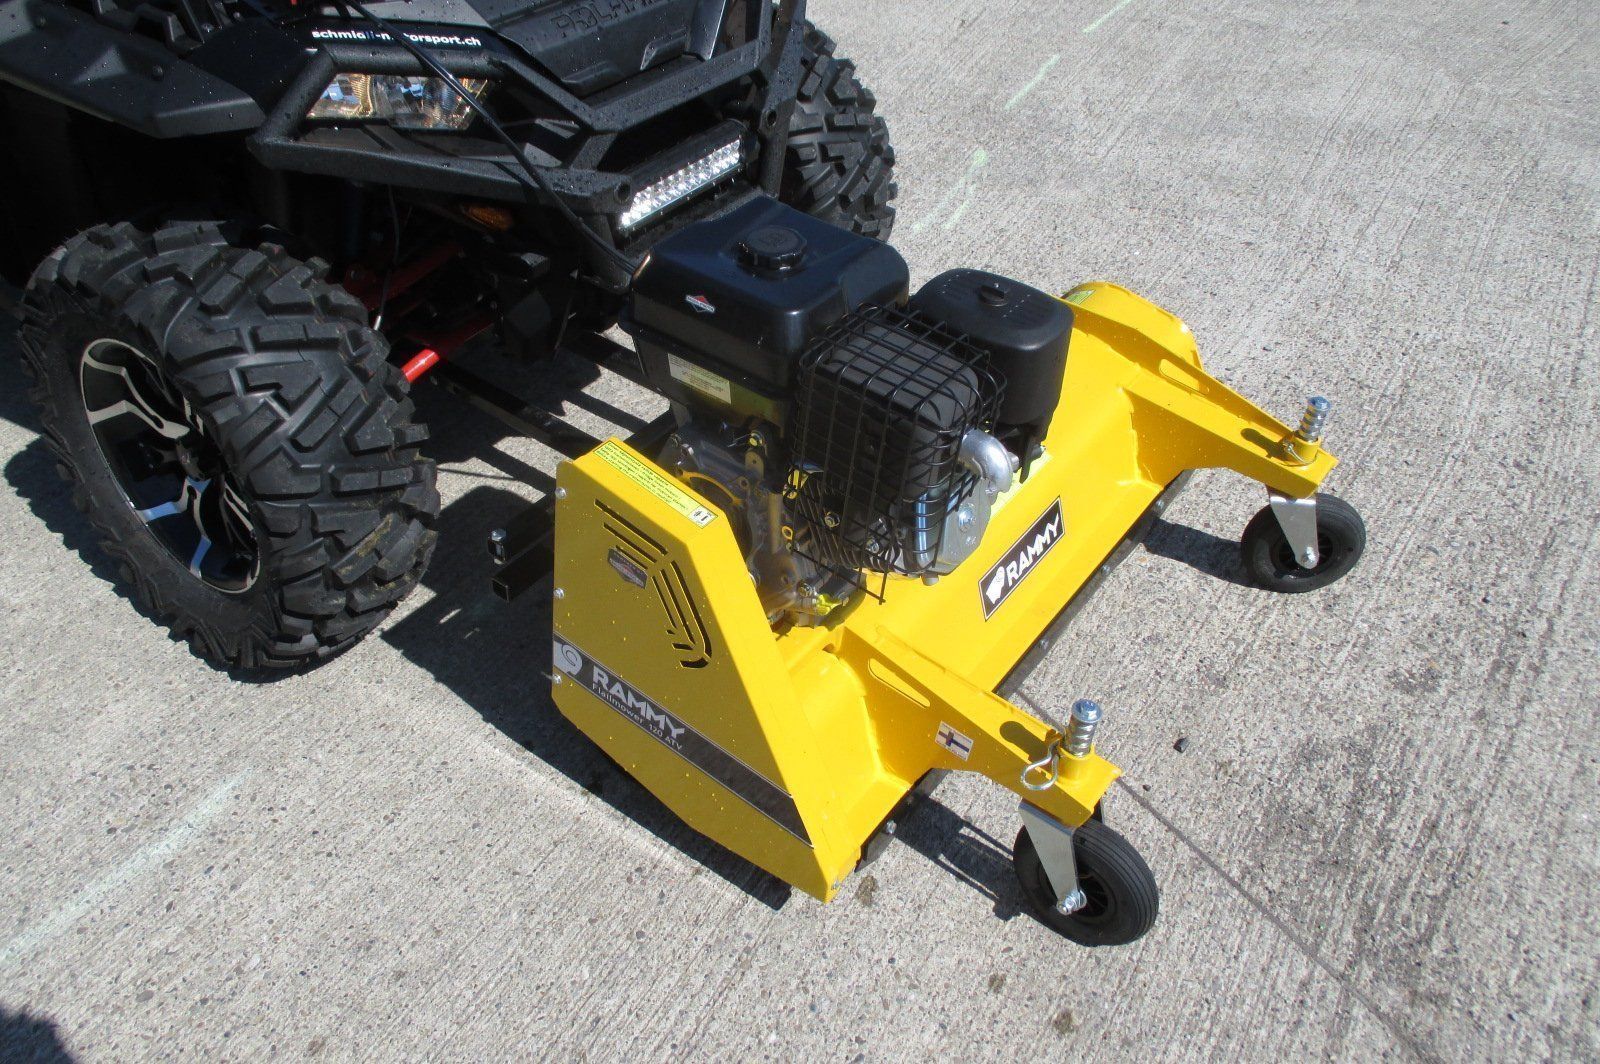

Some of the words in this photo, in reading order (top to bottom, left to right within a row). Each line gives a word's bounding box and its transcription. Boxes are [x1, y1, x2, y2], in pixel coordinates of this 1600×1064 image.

[1007, 513, 1060, 586] RAMMY
[592, 664, 685, 738] RAMMY
[592, 683, 644, 725] Flailmower
[649, 723, 663, 738] 120
[664, 735, 683, 751] ATV
